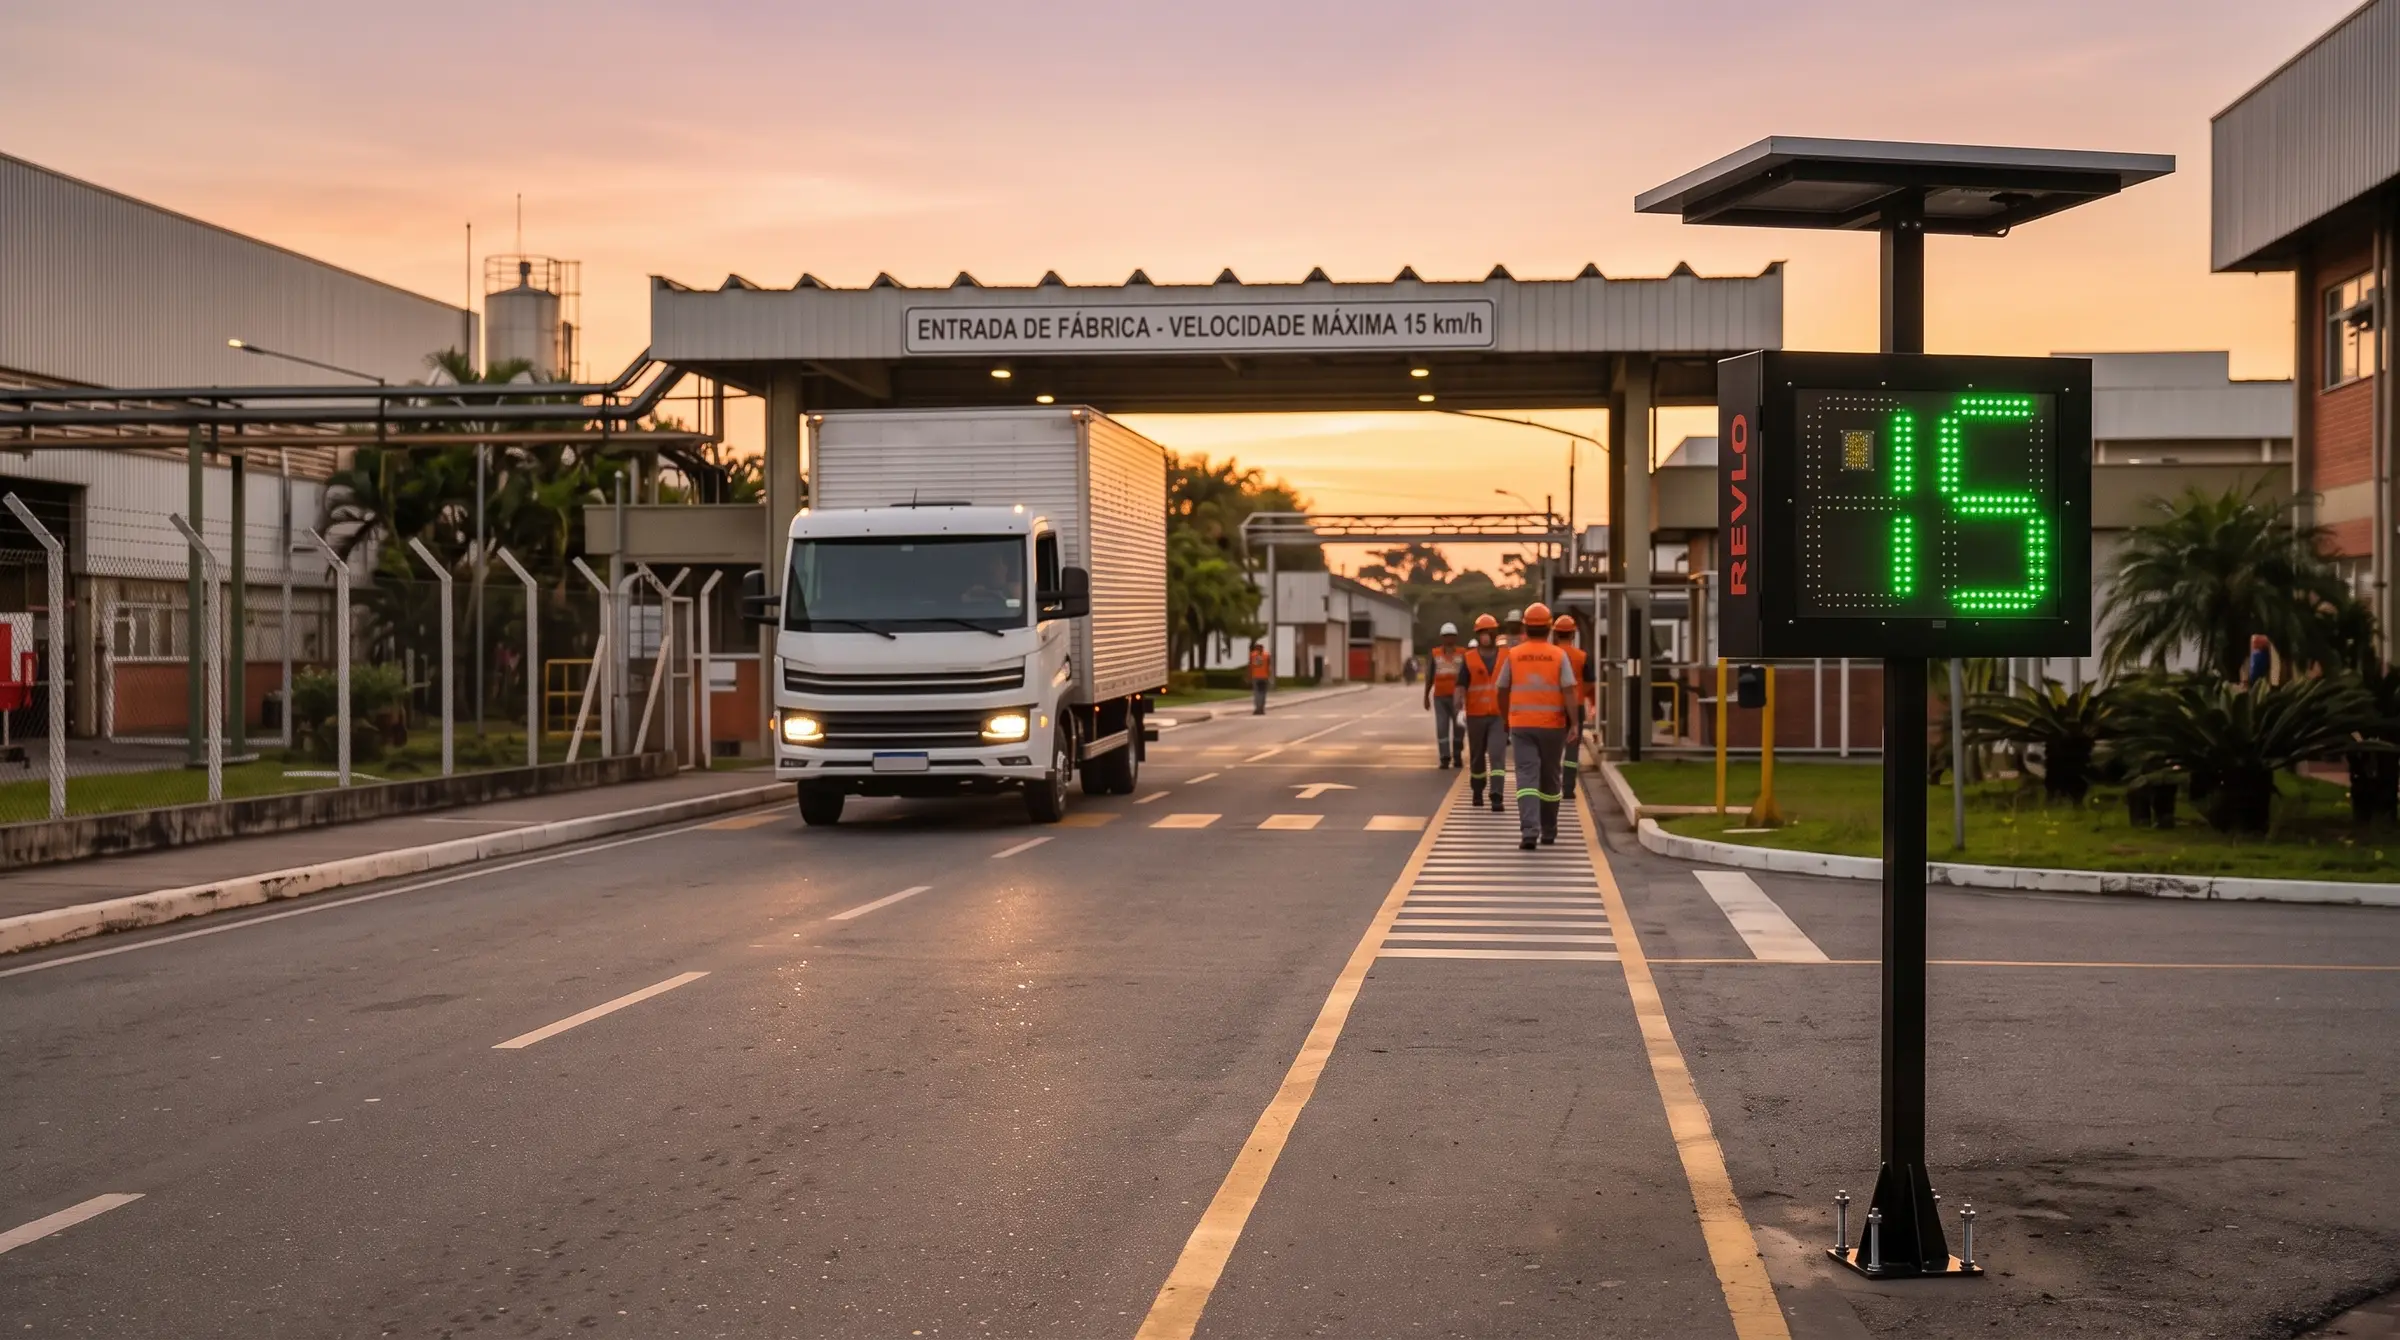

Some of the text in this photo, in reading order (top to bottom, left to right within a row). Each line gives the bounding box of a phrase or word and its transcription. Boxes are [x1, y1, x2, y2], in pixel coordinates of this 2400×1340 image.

[918, 317, 1018, 341] ENTRADA
[1023, 317, 1052, 340] DE
[1058, 310, 1151, 339] FÁBRICA
[1168, 314, 1306, 338] VELOCIDADE
[1312, 307, 1398, 336] MÁXIMA
[1403, 312, 1427, 335] 15
[1433, 311, 1483, 335] km/h
[1730, 414, 1748, 596] REVLO
[1893, 398, 2047, 610] 15
